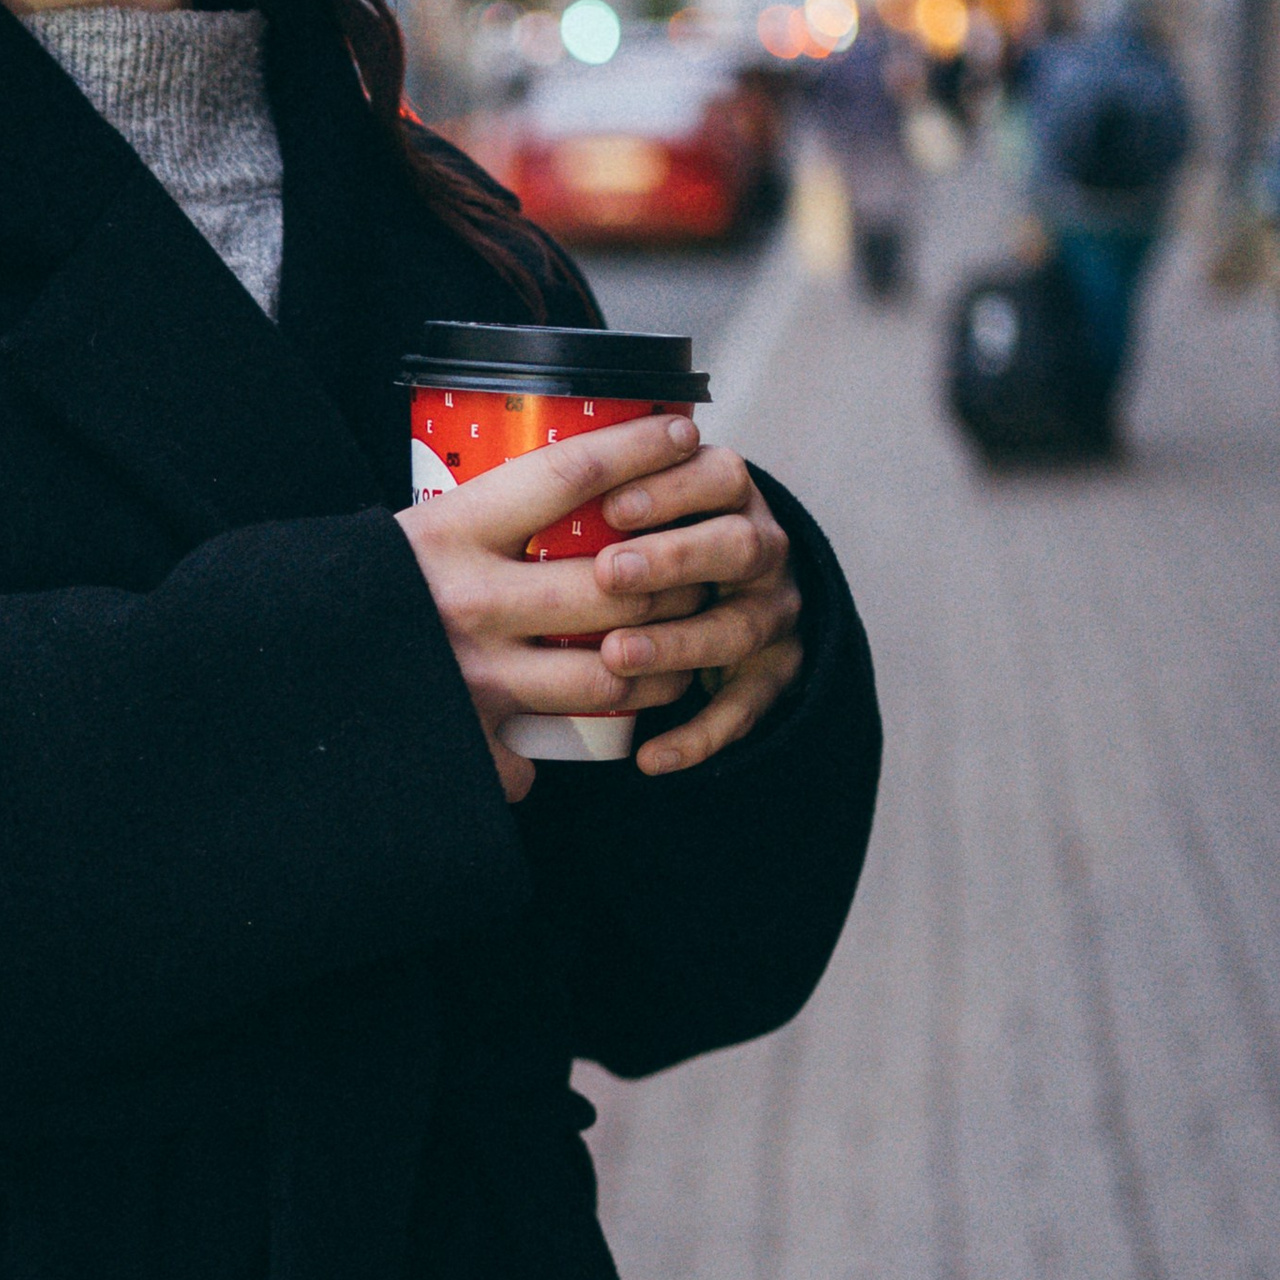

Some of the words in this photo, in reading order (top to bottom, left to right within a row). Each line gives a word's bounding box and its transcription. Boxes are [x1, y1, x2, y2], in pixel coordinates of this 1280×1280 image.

[445, 392, 453, 408] Ц
[583, 401, 595, 417] Ц
[572, 521, 582, 536] Ц
